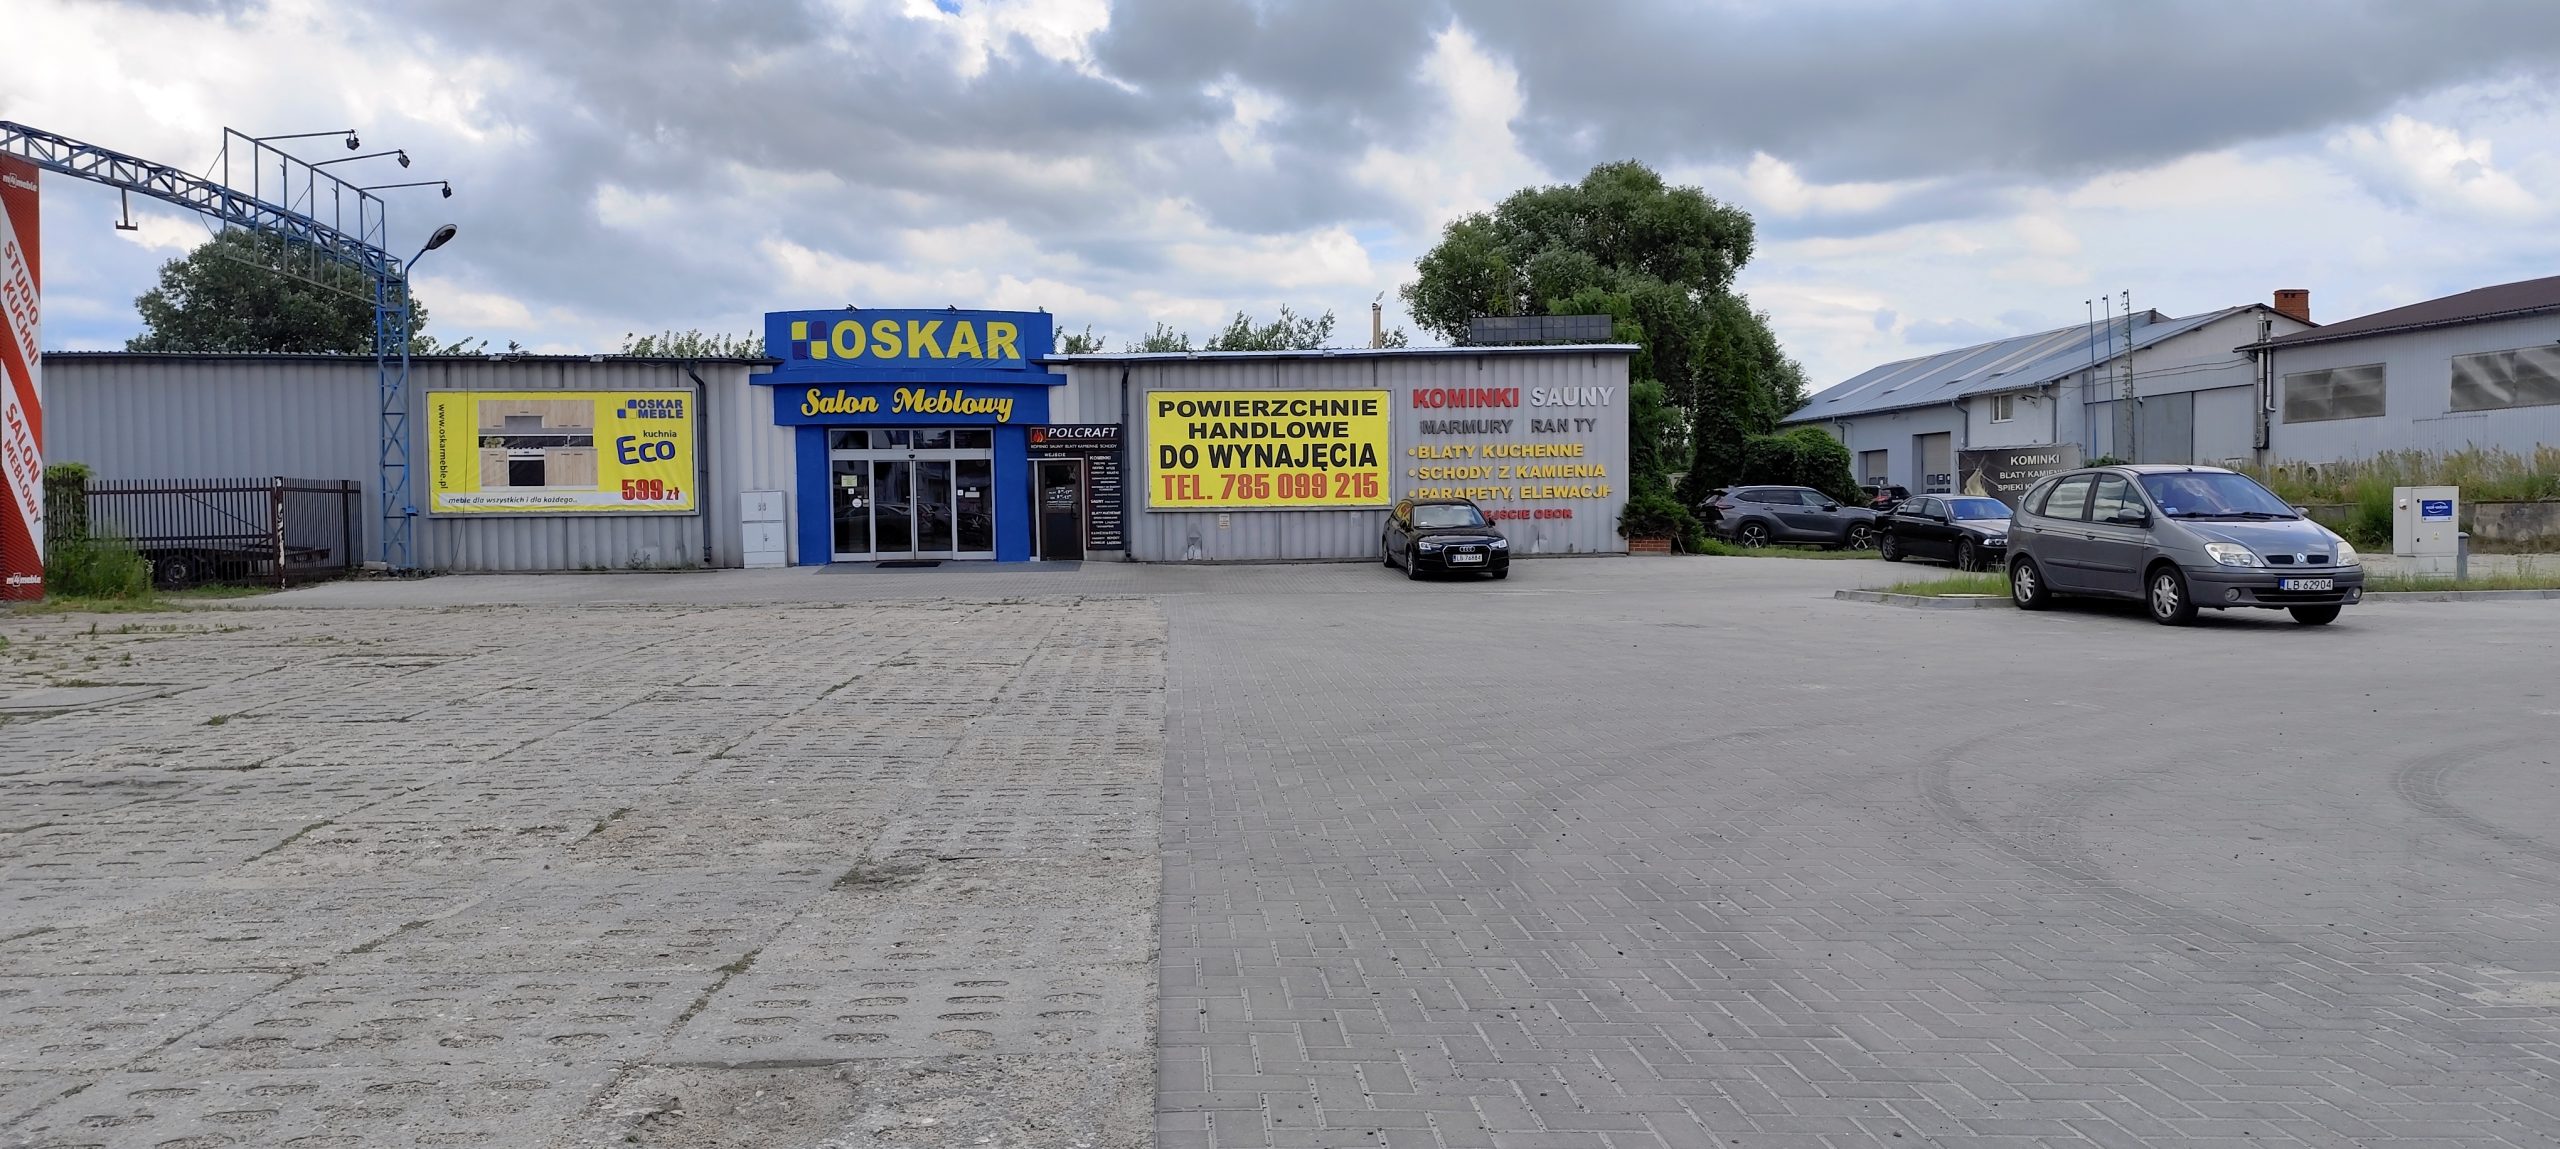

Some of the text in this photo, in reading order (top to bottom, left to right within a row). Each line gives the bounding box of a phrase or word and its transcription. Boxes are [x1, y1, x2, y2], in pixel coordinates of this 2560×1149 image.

[5, 240, 39, 326] STUDIO
[3, 279, 39, 366] KUCHNI
[831, 320, 1021, 360] OSKAR
[638, 399, 683, 409] OSKAR
[801, 387, 1014, 423] Salon Meblowy
[1412, 386, 1616, 409] KOMINKI SAUNY
[638, 409, 684, 419] MEBLE
[1158, 399, 1378, 418] POWIERZCHNIE
[643, 430, 677, 438] kuchnia
[1048, 427, 1118, 438] POLCRAFT
[1188, 421, 1350, 440] HANDLOWE
[1420, 418, 1514, 435] MARMURY
[6, 402, 40, 485] SALON
[439, 403, 449, 489] www.oskarmeble.pl
[616, 435, 676, 465] Eco
[1418, 443, 1584, 459] BLATY KUCHENNE
[1159, 443, 1378, 472] DO WYNAJĘCIA
[2010, 454, 2060, 466] KOMINKI
[1418, 464, 1607, 480] SCHODY Z KAMIENIA
[2000, 471, 2026, 479] BLATY
[4, 438, 42, 526] MEBLOWY
[621, 479, 680, 501] 599 zł
[1161, 472, 1379, 501] TEL. 785 099 215
[1997, 483, 2024, 492] SPIEKI
[486, 496, 525, 505] wszystkich
[1418, 487, 1514, 502] PARAPETY,
[1483, 506, 1531, 520] EJŚCIE
[2286, 579, 2332, 590] LB 62904
